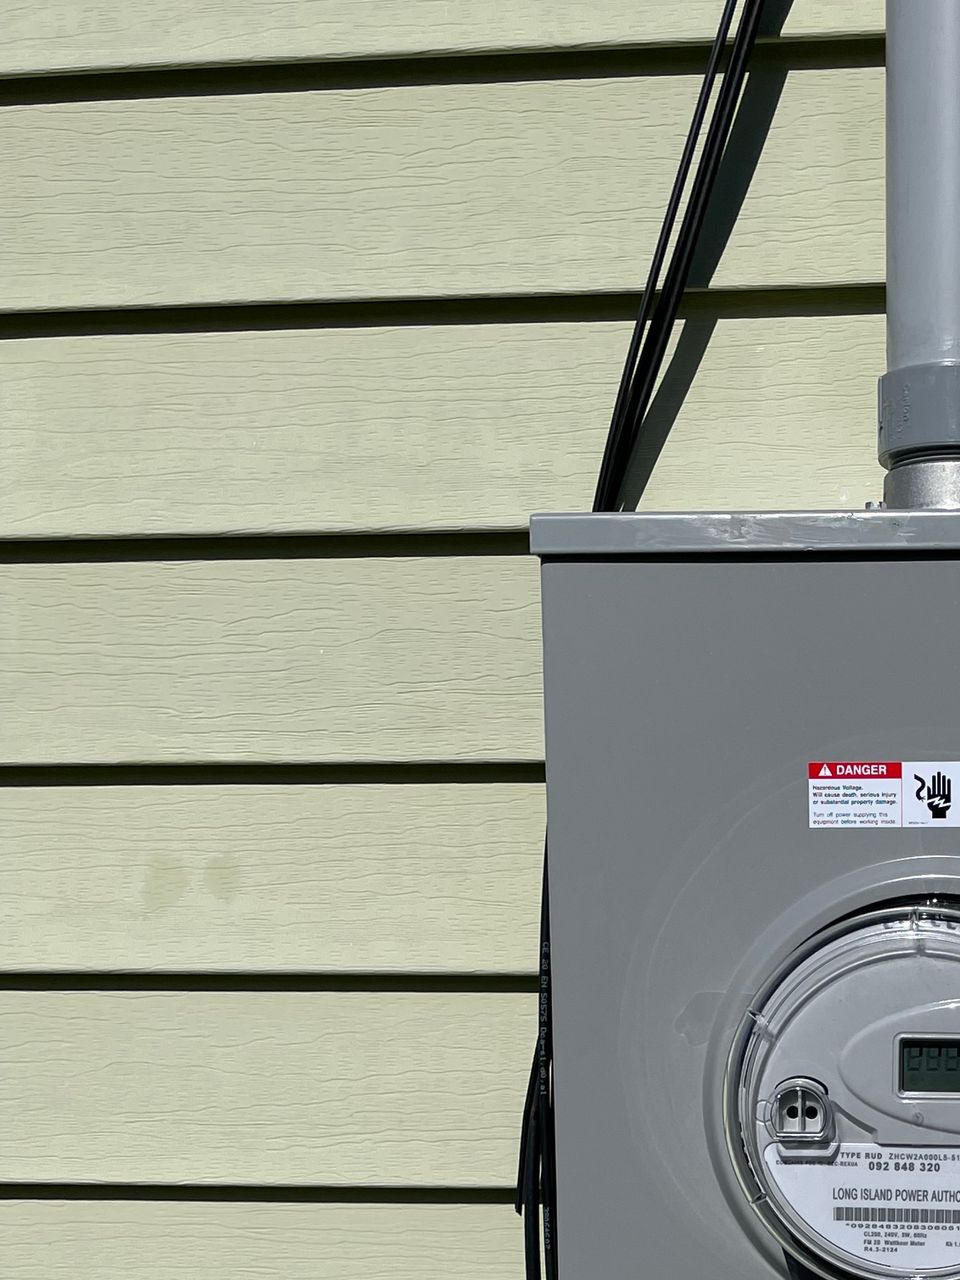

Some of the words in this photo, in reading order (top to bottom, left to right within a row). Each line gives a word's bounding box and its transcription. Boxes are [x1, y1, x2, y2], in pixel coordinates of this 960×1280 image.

[836, 764, 887, 776] DANGER
[542, 942, 549, 954] CE
[541, 959, 548, 970] 20
[541, 976, 548, 988] EN
[540, 993, 548, 1022] 50575
[869, 1162, 889, 1171] 092
[894, 1163, 915, 1171] 848
[920, 1163, 941, 1172] 320
[833, 1188, 858, 1200] LONG
[861, 1188, 892, 1201] ISLAND
[895, 1189, 928, 1202] POWER
